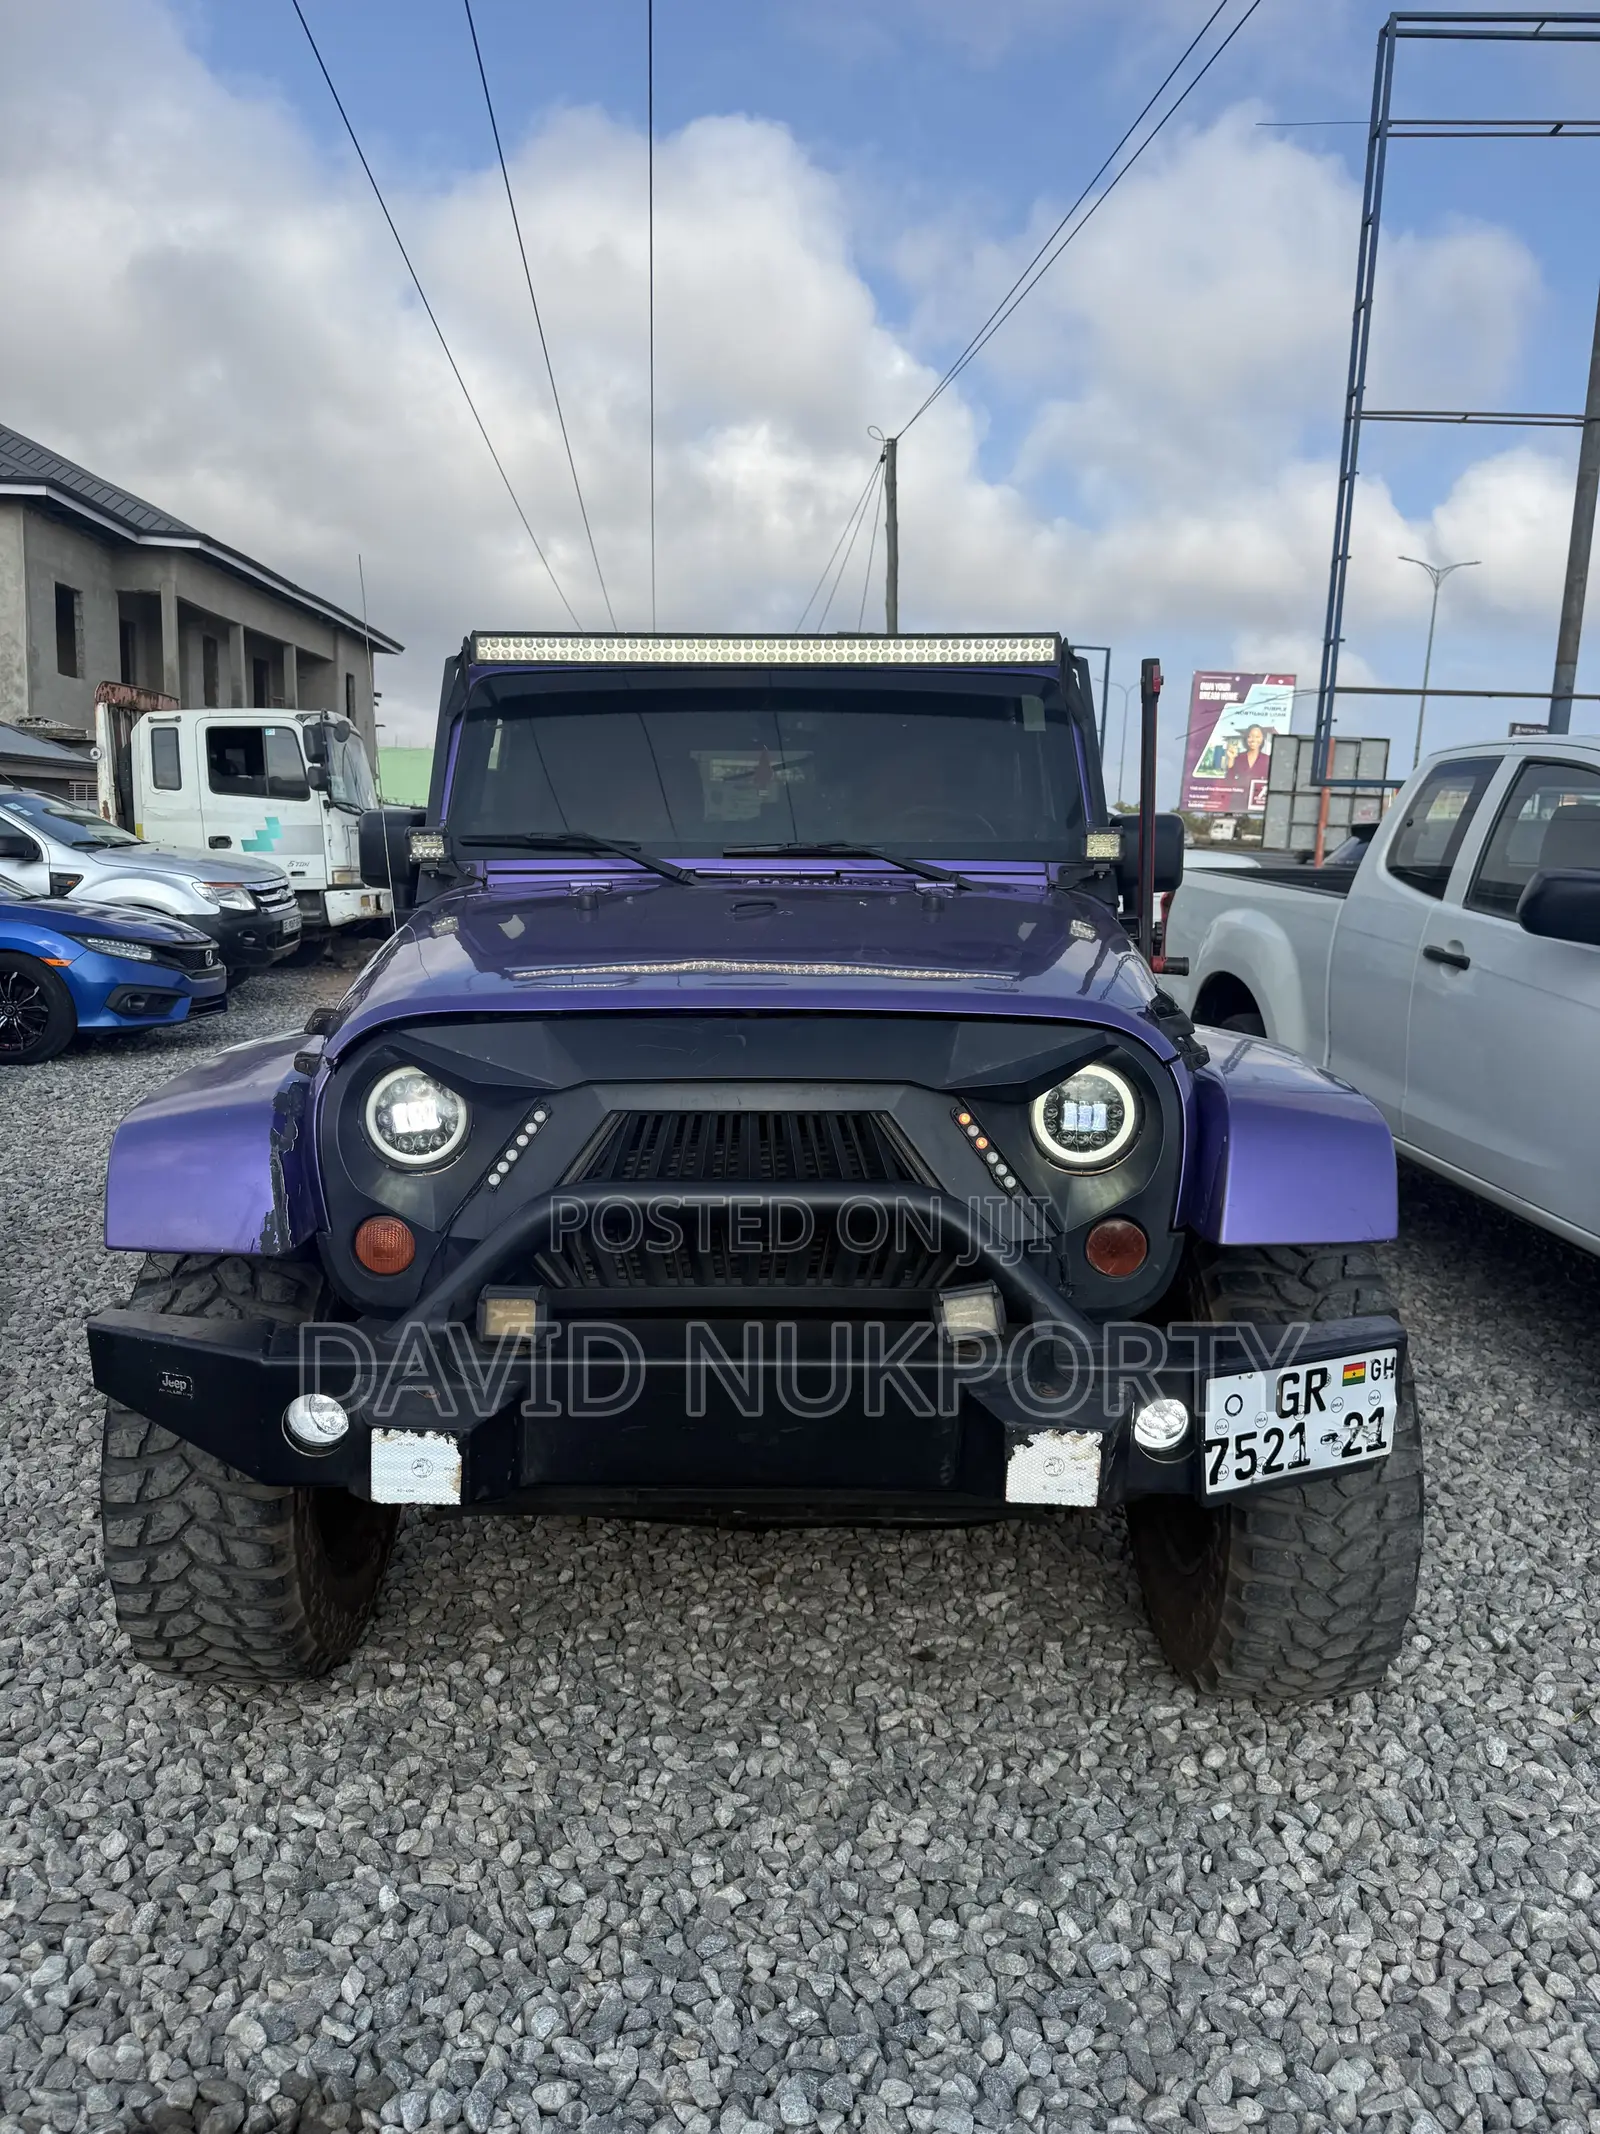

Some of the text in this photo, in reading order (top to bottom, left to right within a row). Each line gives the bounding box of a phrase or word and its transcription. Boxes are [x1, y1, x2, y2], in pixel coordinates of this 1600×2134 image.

[162, 1375, 187, 1391] Jeep
[1276, 1356, 1396, 1419] GR GH
